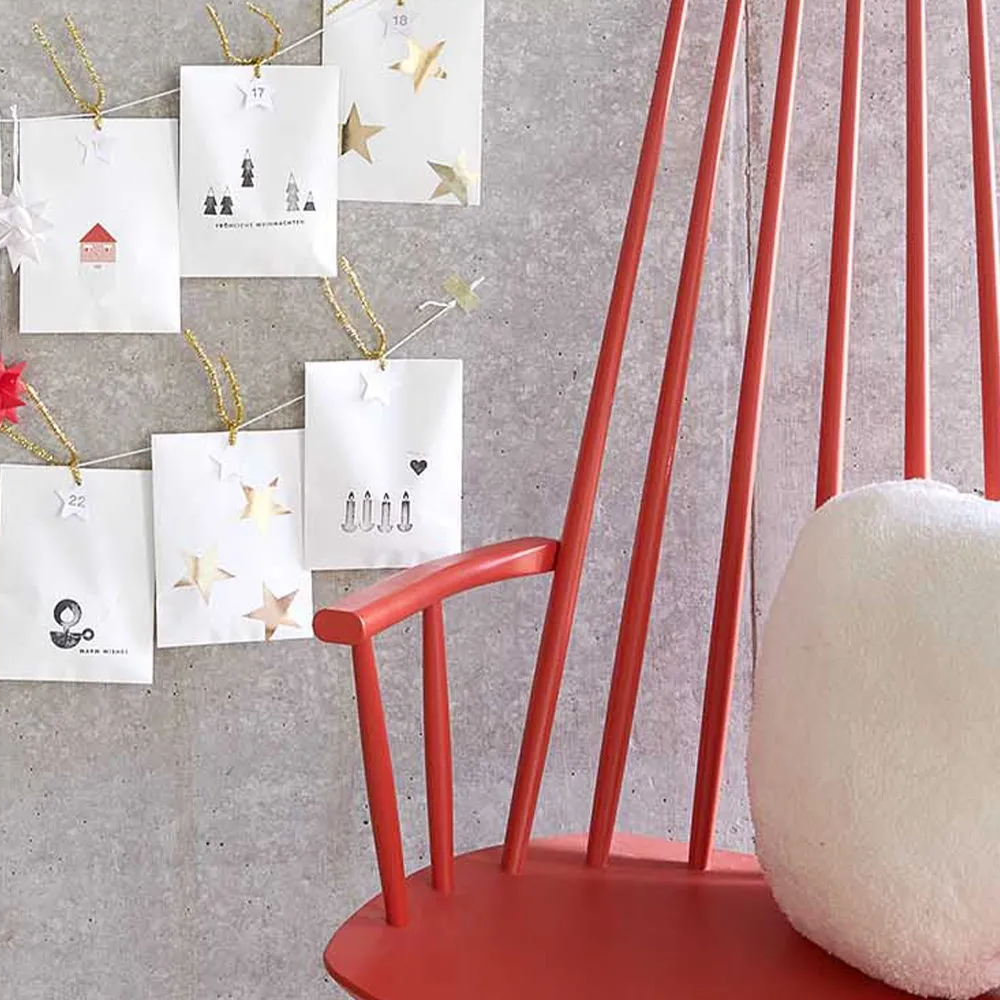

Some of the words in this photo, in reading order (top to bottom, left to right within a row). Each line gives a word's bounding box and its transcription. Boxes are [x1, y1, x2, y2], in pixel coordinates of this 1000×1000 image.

[392, 14, 408, 27] 18
[250, 86, 266, 99] 17
[69, 494, 87, 509] 22
